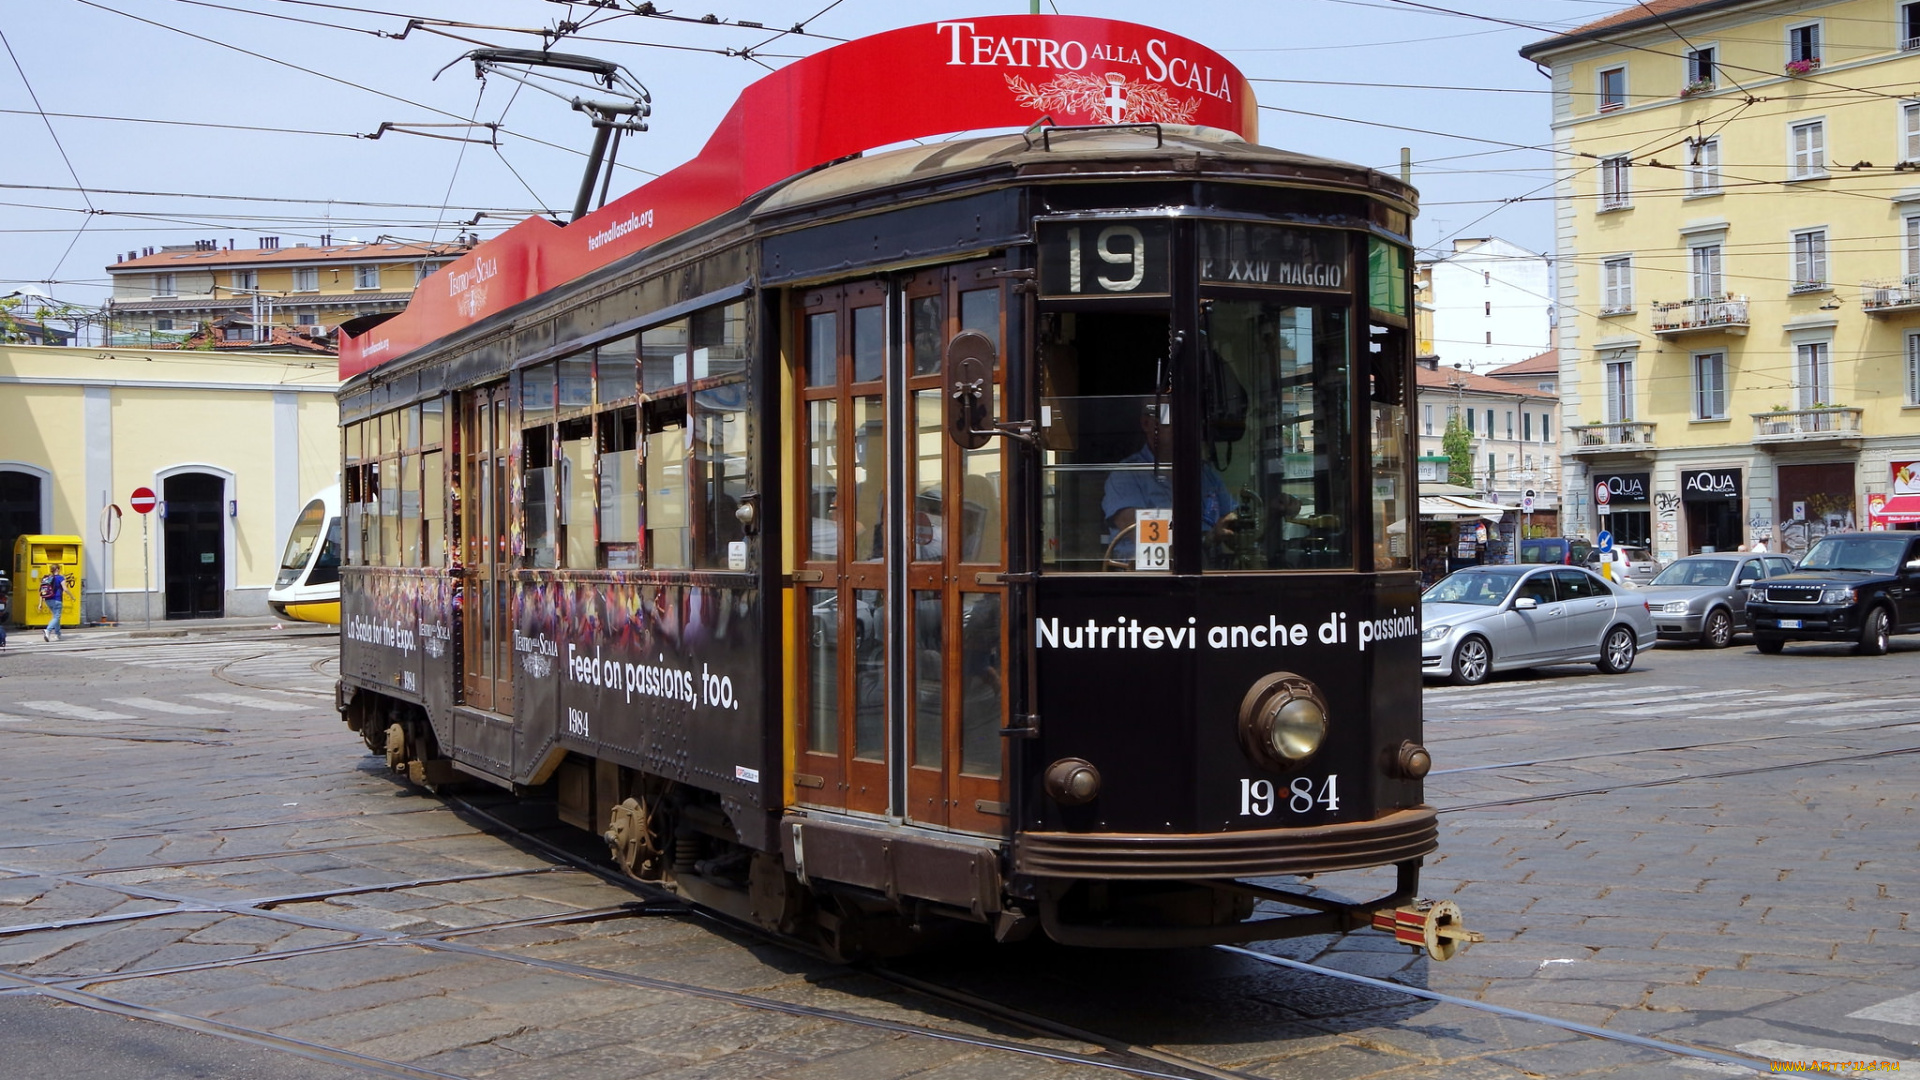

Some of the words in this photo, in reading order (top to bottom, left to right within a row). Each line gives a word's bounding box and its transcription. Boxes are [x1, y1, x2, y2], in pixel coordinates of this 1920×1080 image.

[937, 22, 1088, 70] TEATRO
[1091, 43, 1142, 66] ALLA
[1145, 38, 1232, 103] SCALA
[588, 209, 654, 252] teatroallascala.org
[1066, 225, 1145, 293] 19
[1228, 260, 1271, 283] XXIV
[1280, 262, 1342, 288] MAGGIO
[1607, 476, 1643, 496] QUA
[1686, 472, 1735, 492] AQUA
[1148, 521, 1160, 542] 3
[1143, 546, 1166, 567] 19
[347, 613, 355, 639] La
[355, 614, 373, 643] Scala
[373, 616, 383, 645] for
[383, 617, 395, 647] the
[396, 620, 417, 658] Expo.
[1036, 616, 1196, 650] Nutritevi
[1208, 615, 1308, 647] anche
[1318, 612, 1347, 644] di
[1358, 605, 1418, 652] passioni.
[568, 643, 600, 686] Feed
[604, 660, 622, 690] on
[625, 652, 698, 711] passions,
[702, 662, 739, 711] too.
[568, 706, 589, 737] 1984
[1239, 774, 1340, 816] 1984
